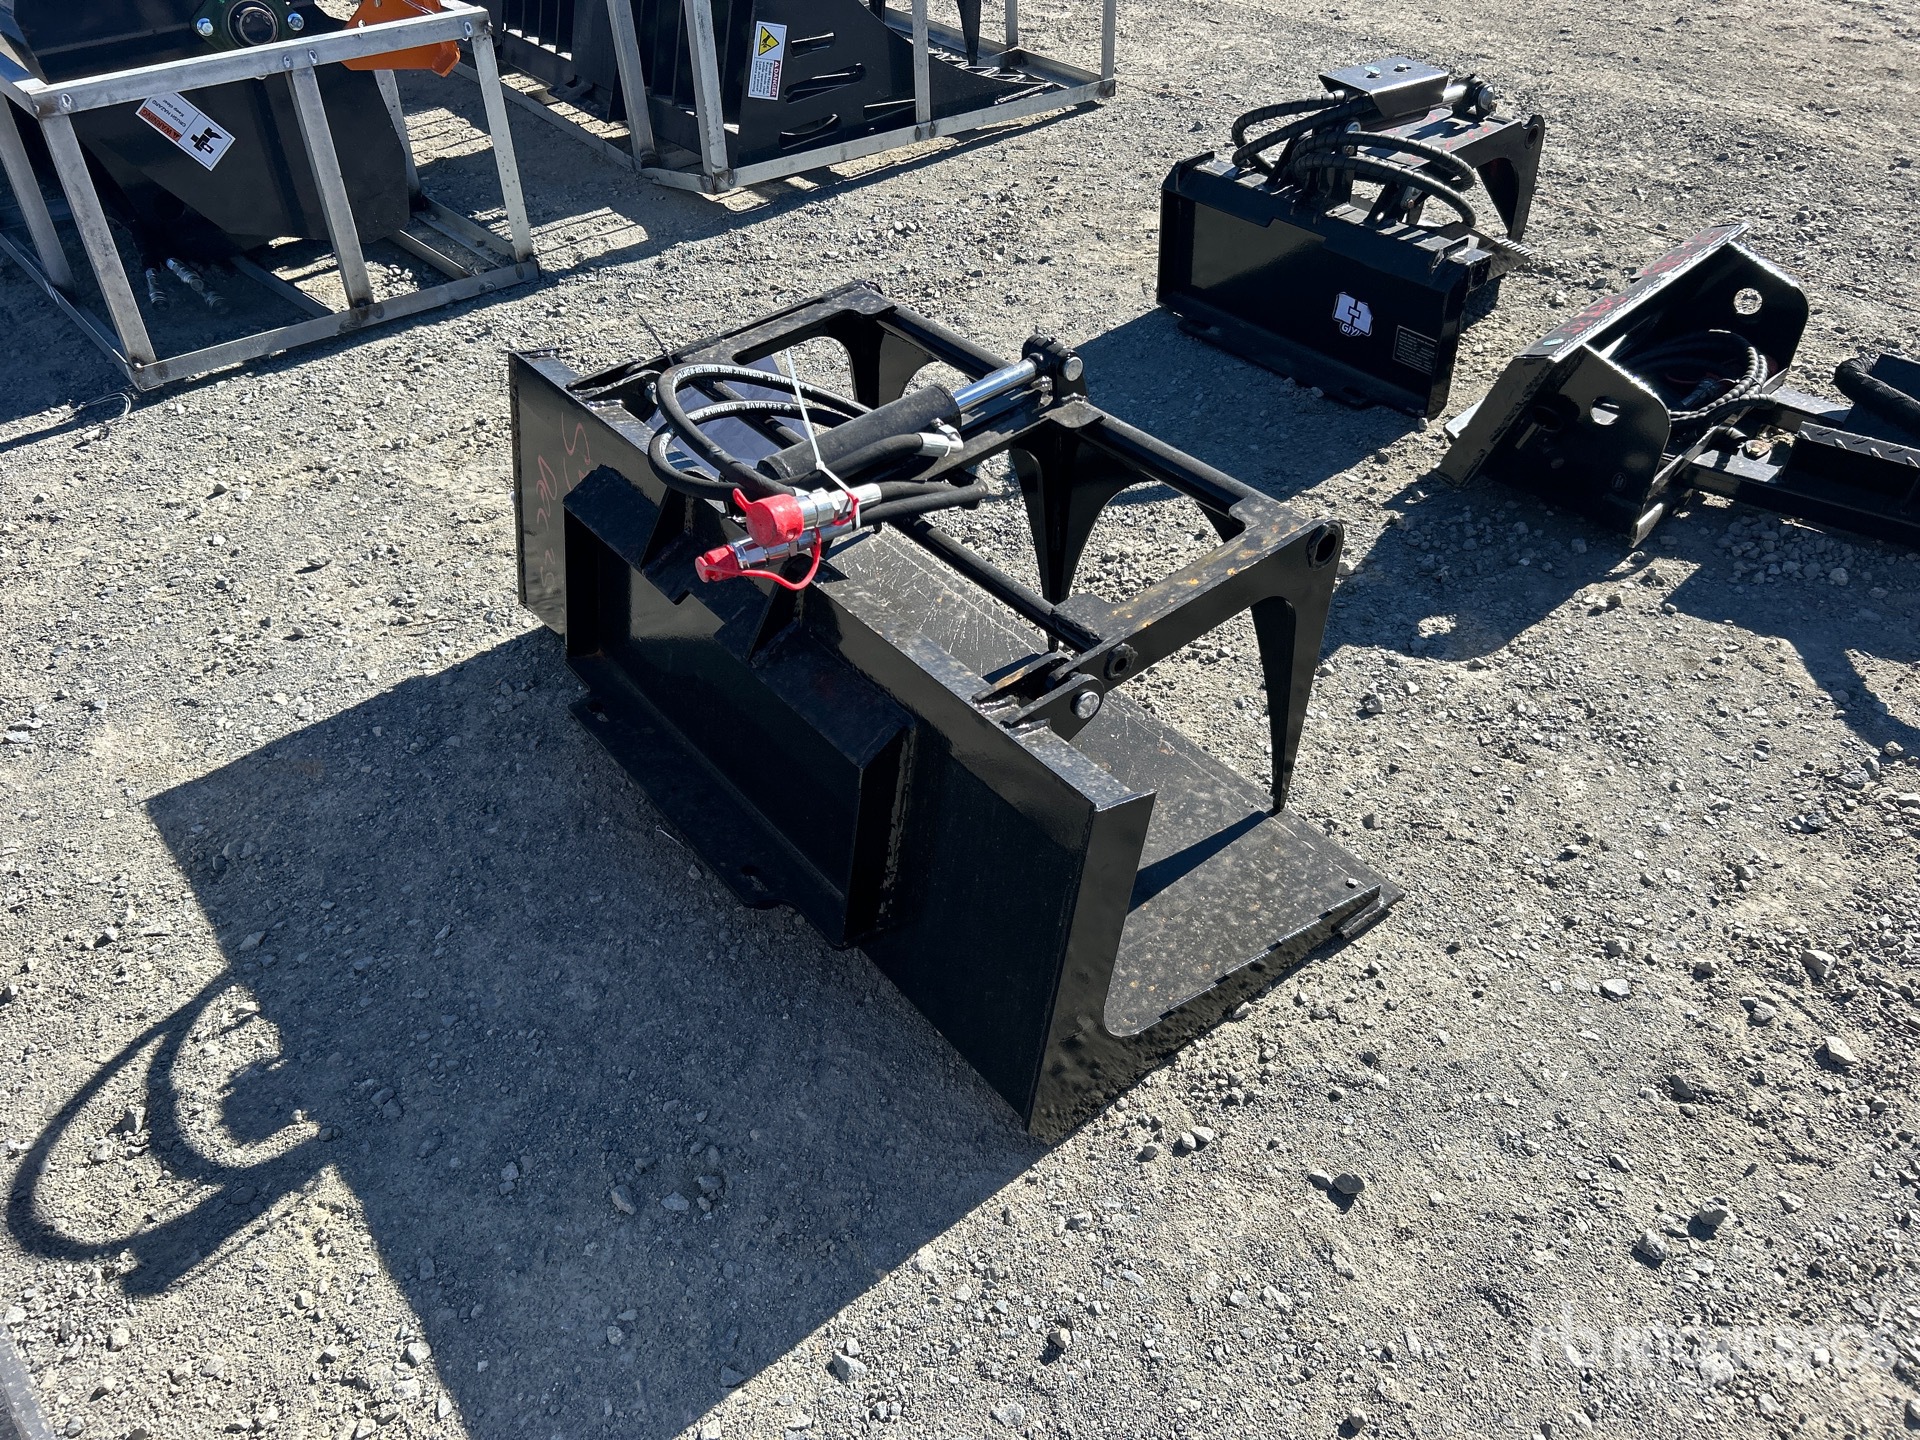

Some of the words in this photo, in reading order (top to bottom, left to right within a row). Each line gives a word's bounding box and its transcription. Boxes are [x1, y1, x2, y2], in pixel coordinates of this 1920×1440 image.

[152, 100, 171, 116] HAZARD
[142, 109, 172, 135] WARNING
[170, 114, 186, 128] CRUSH
[706, 404, 736, 416] HYDRAULIC
